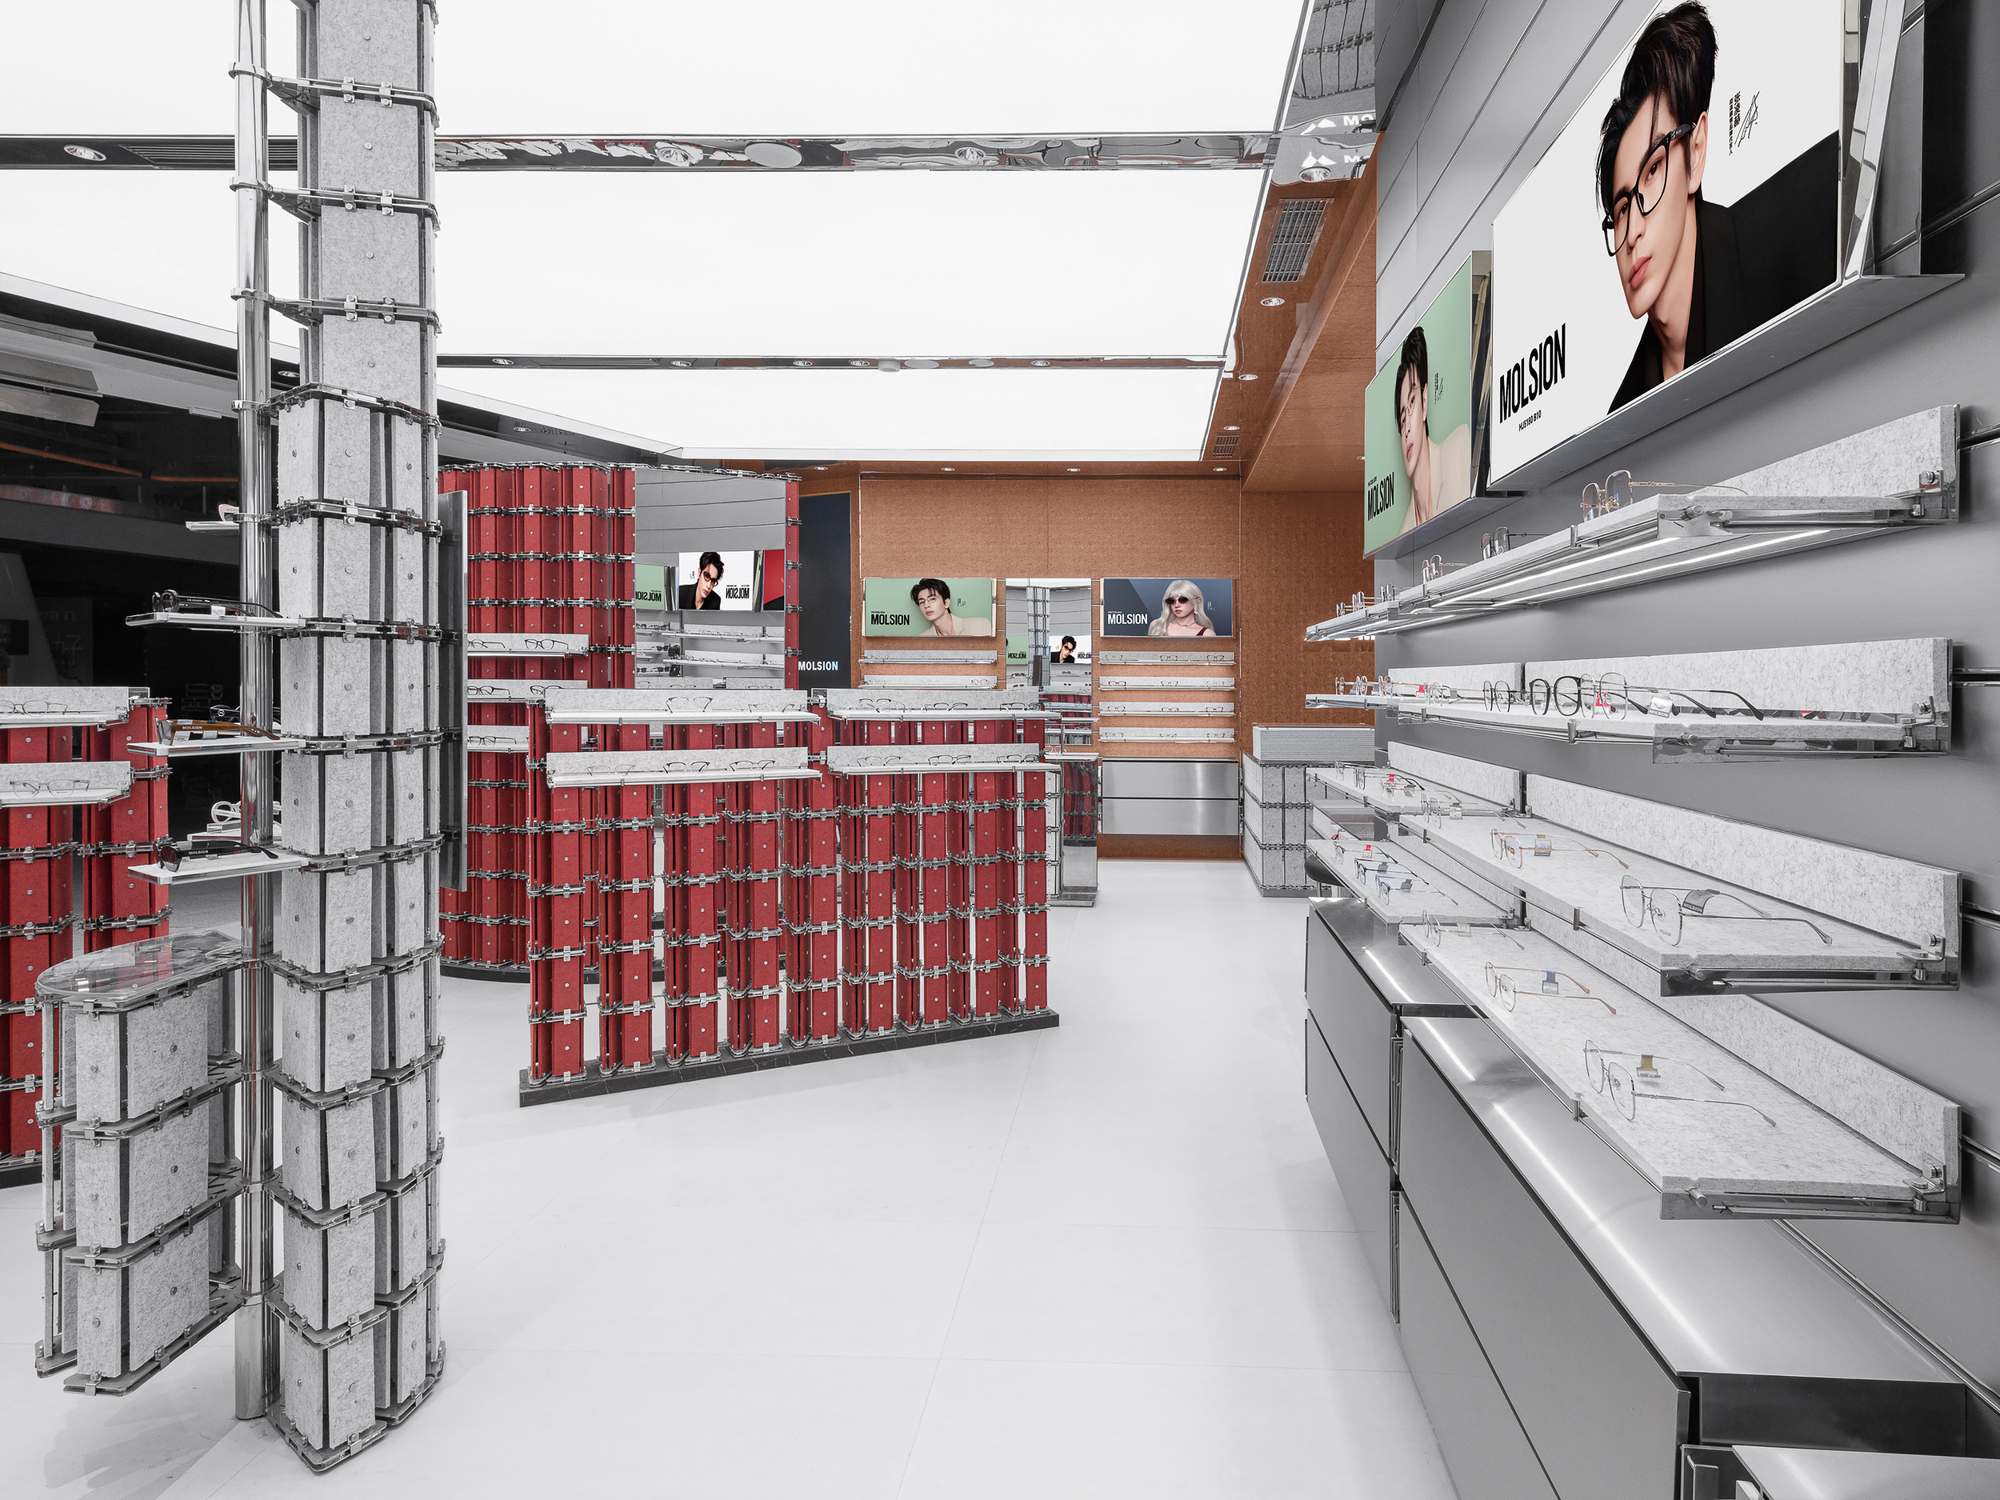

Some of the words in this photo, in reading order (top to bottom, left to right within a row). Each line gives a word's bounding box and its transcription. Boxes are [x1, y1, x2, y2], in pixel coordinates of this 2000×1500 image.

[1500, 322, 1565, 424] MOLSION
[1368, 472, 1394, 521] MOLSION
[870, 613, 910, 625] MOLSION
[1107, 613, 1148, 625] MOLSION
[798, 661, 839, 671] MOLSION
